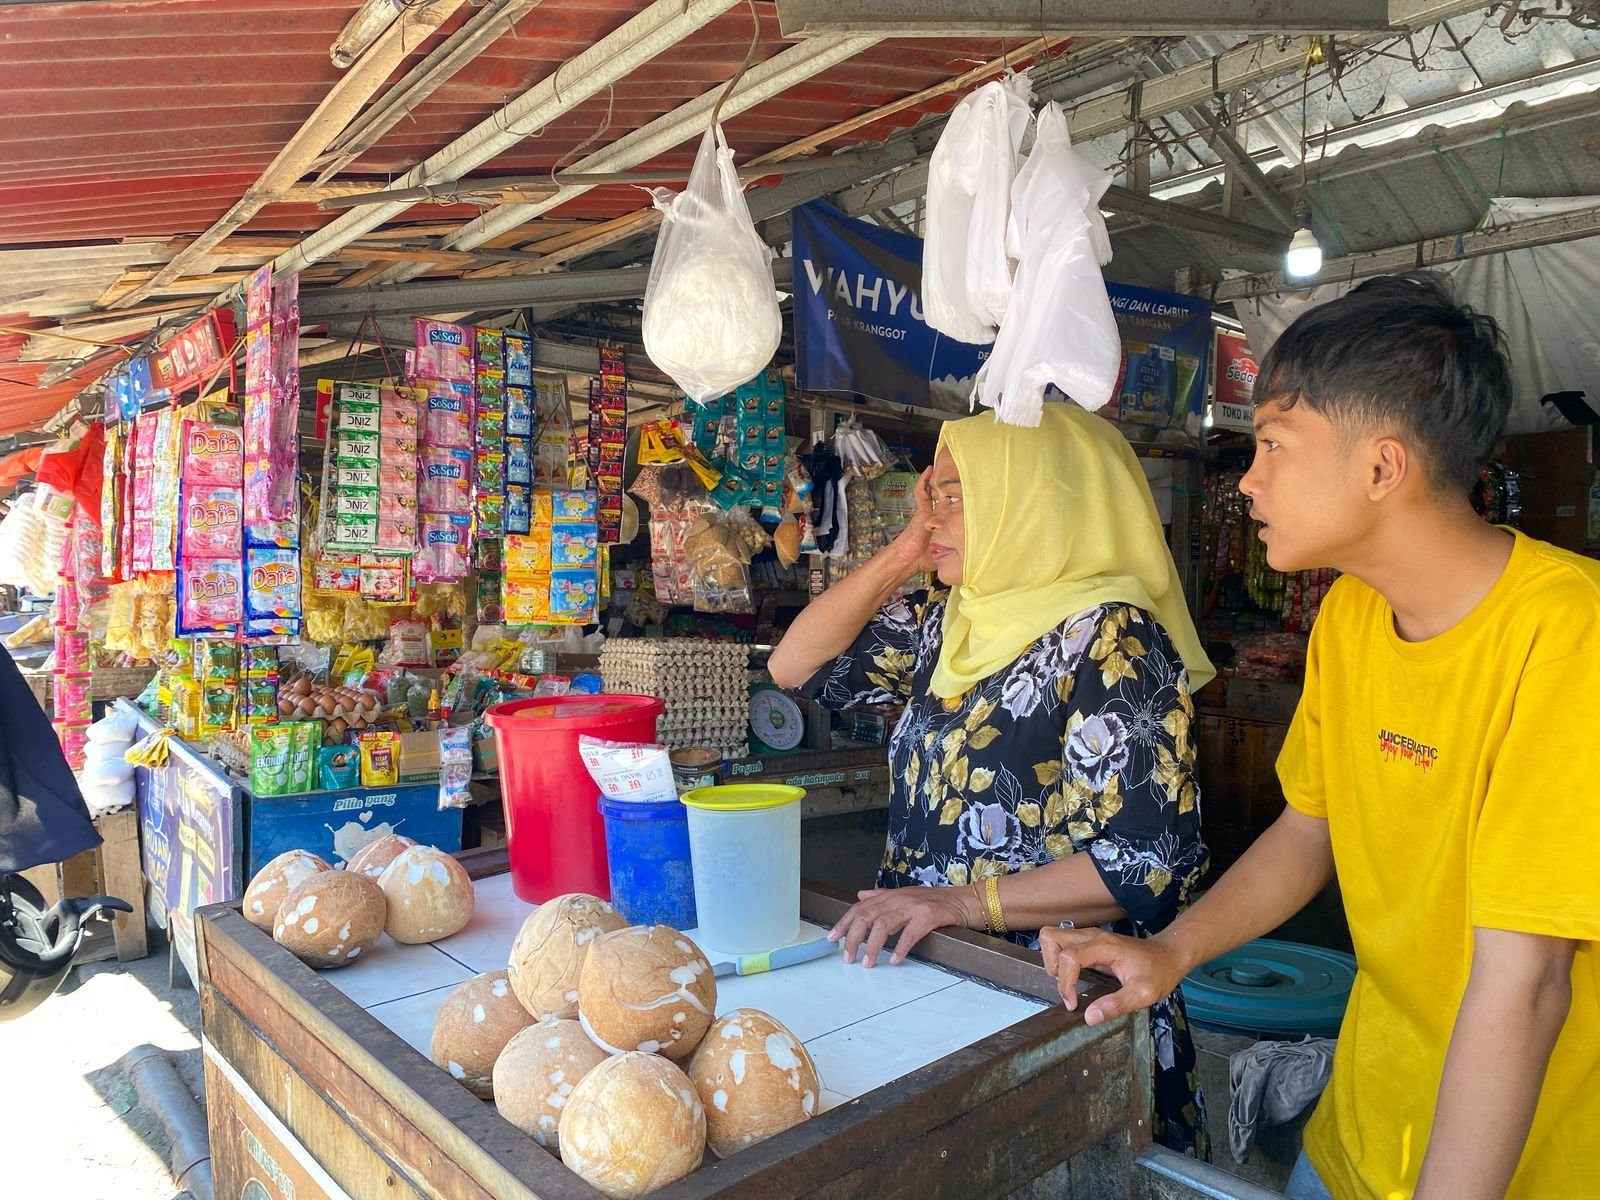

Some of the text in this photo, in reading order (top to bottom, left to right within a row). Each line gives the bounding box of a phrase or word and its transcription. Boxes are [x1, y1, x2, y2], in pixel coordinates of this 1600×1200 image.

[803, 259, 925, 321] WAHYU
[1108, 296, 1190, 318] NGI DAN LEMBUT
[854, 320, 907, 341] KRANGGOT
[1128, 316, 1172, 330] TANGAN
[1227, 366, 1257, 384] Seda
[348, 391, 371, 399] ZINC
[1222, 405, 1242, 420] TOKO
[347, 416, 371, 426] ZINC
[191, 430, 240, 454] Daia
[347, 443, 370, 454] ZINC
[346, 472, 369, 481] ZINC
[345, 500, 369, 510] ZINC
[190, 502, 239, 528] Daia
[344, 529, 368, 539] ZINC
[252, 565, 298, 590] Daia
[190, 575, 238, 600] Daia
[364, 793, 397, 808] yang
